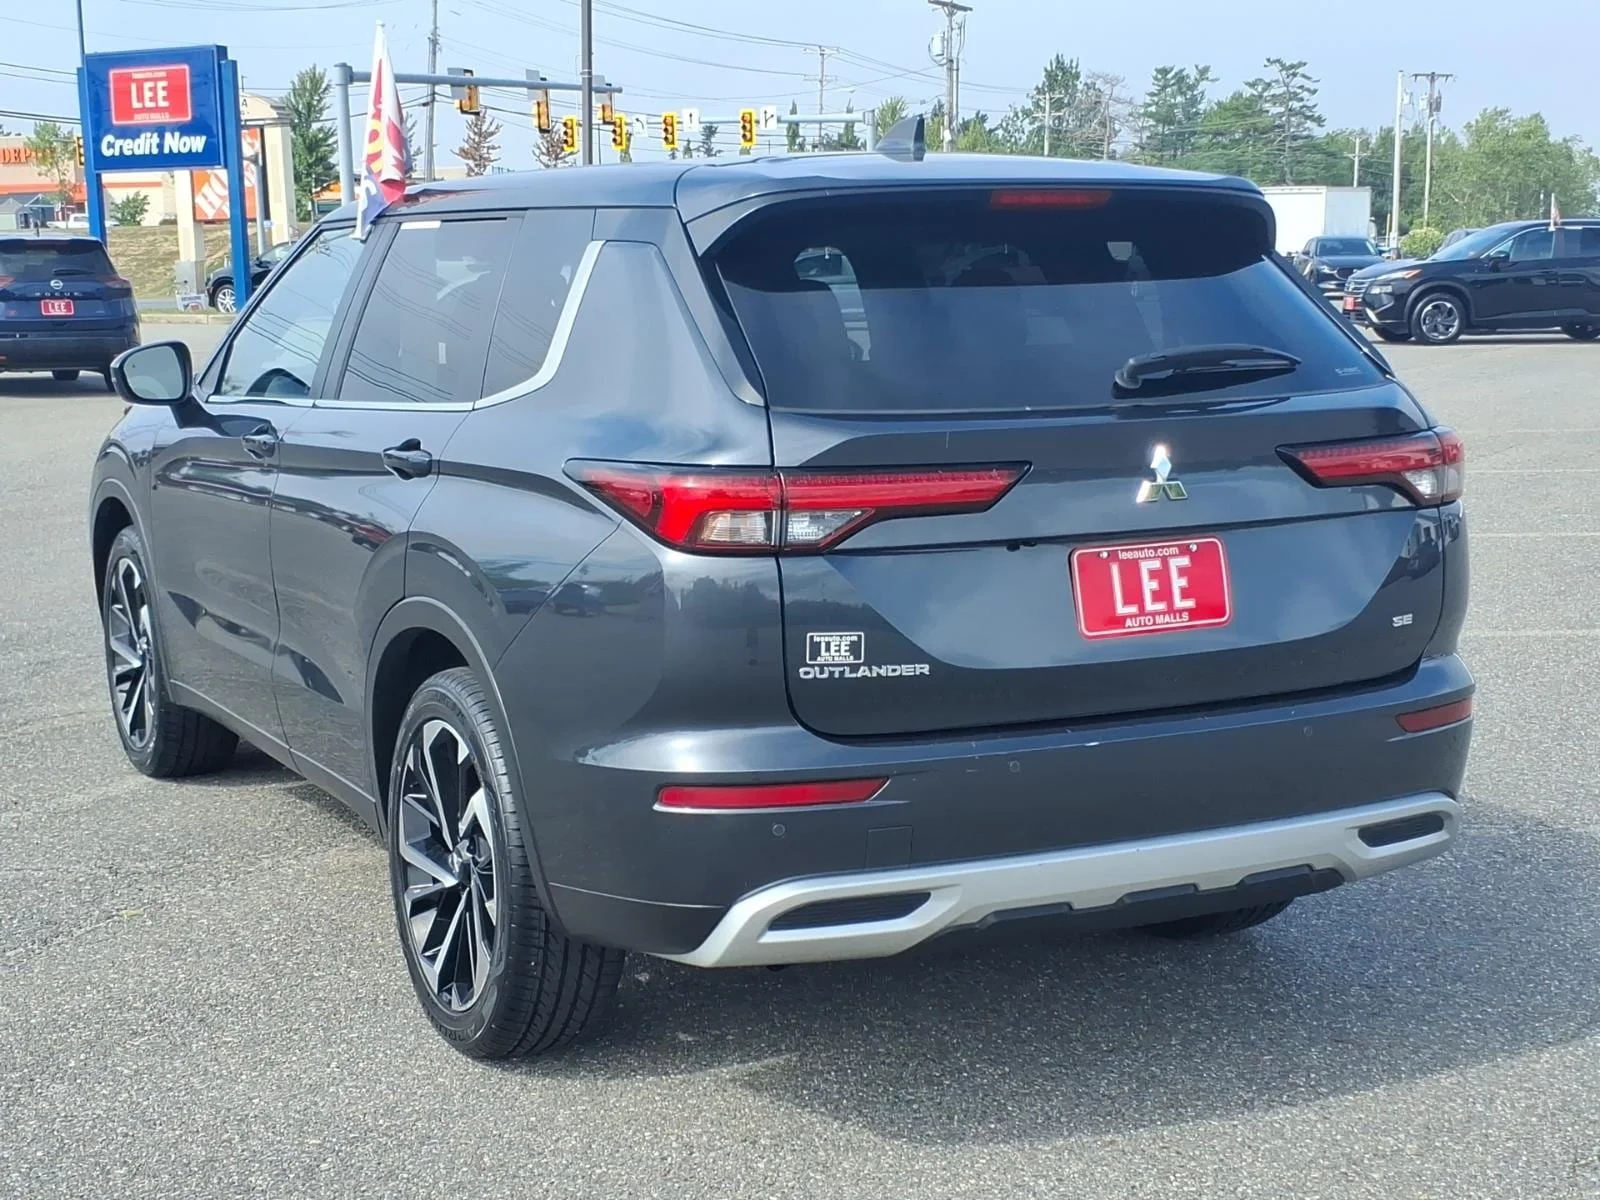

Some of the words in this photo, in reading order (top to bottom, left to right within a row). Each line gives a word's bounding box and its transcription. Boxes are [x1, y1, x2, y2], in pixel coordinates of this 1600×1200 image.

[130, 80, 170, 109] LEE
[101, 132, 160, 156] Credit
[163, 132, 207, 154] Now
[48, 302, 67, 312] LEE
[1118, 546, 1179, 560] leeauto.com
[1110, 555, 1197, 616] LEE
[1125, 615, 1154, 628] AUTO
[1155, 611, 1190, 625] MALLS
[1392, 613, 1413, 627] SE
[820, 641, 851, 657] LEE
[799, 663, 931, 679] OUTLANDER
